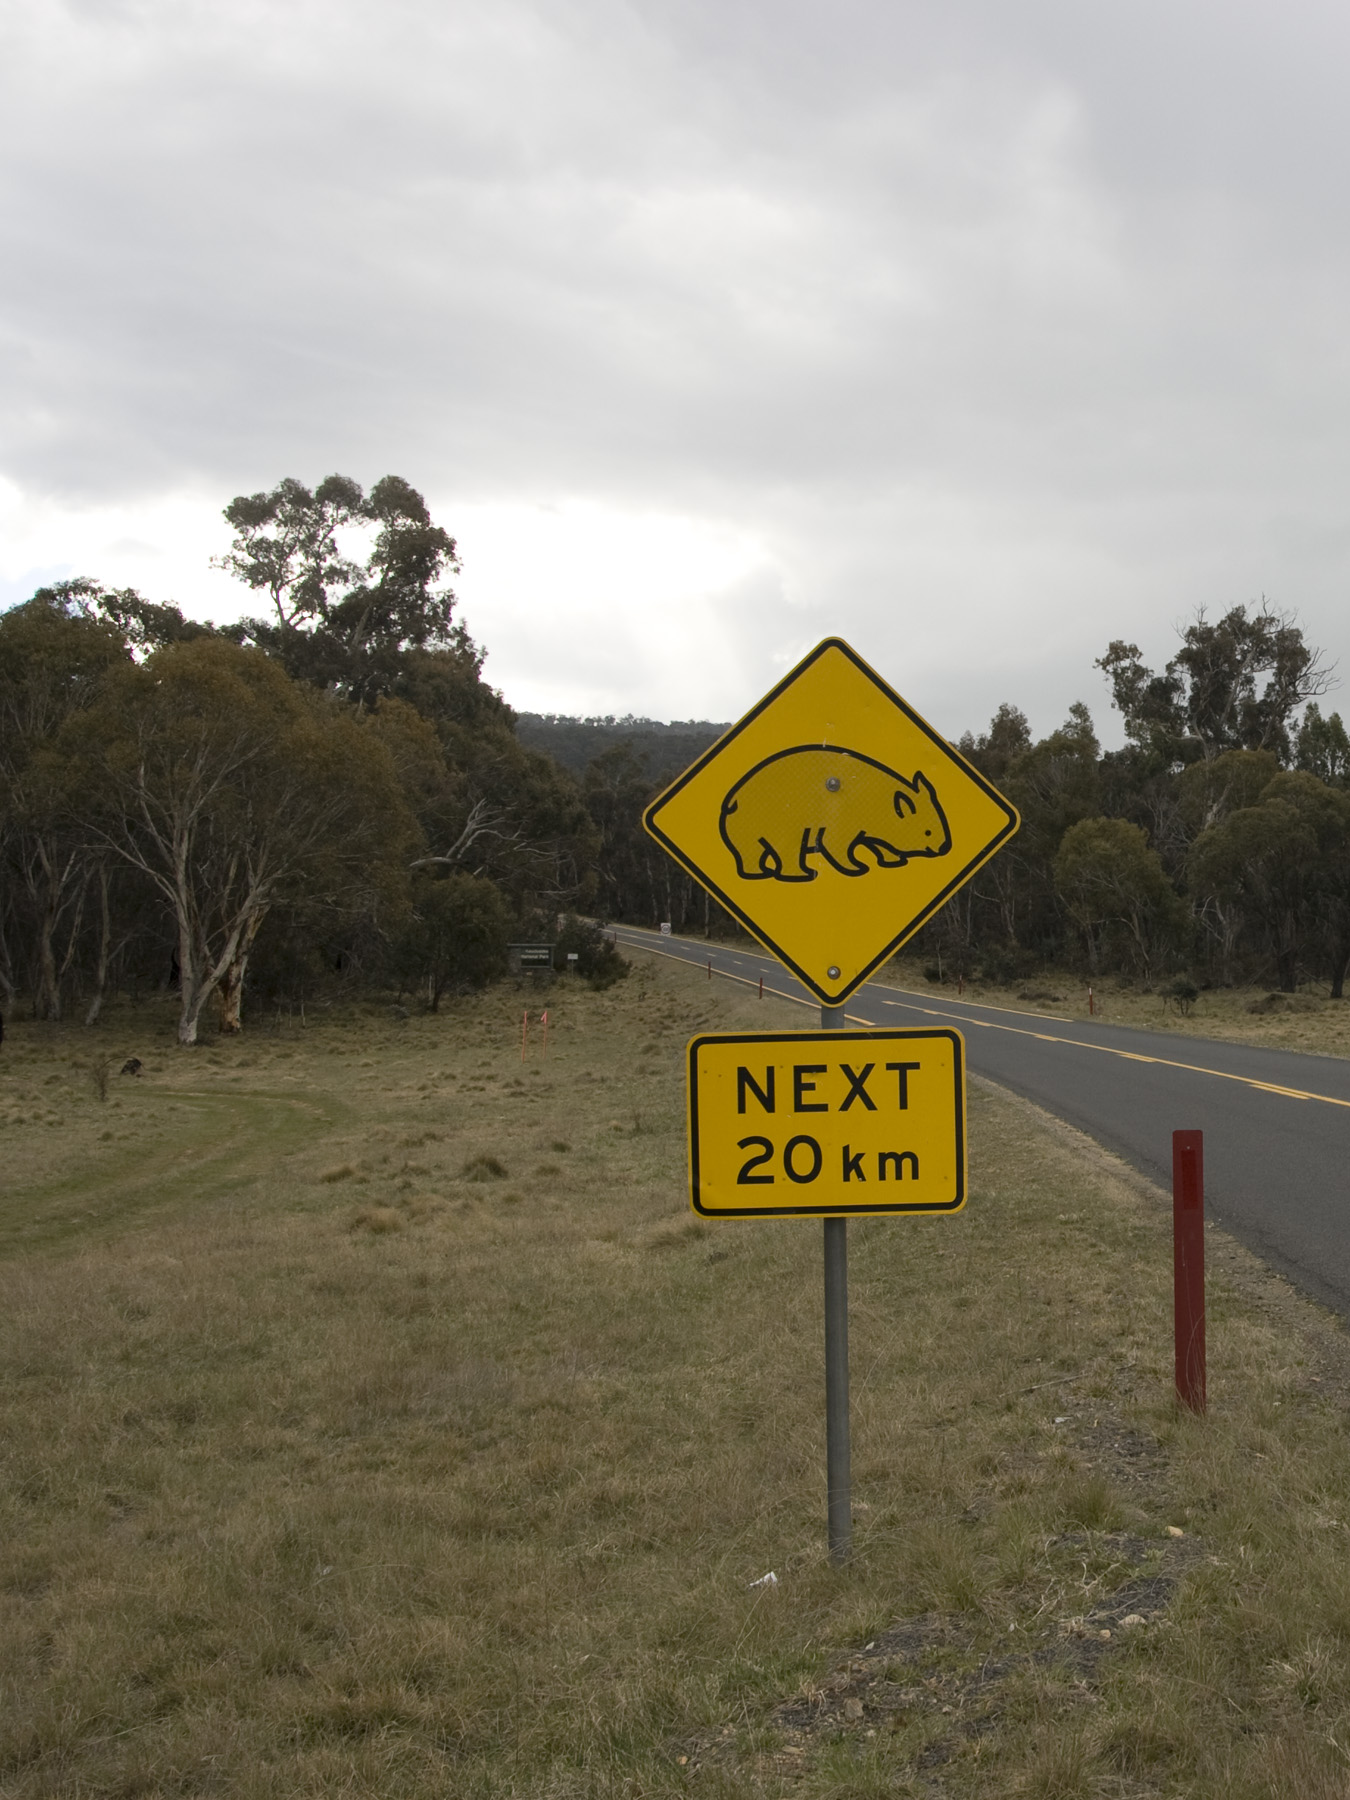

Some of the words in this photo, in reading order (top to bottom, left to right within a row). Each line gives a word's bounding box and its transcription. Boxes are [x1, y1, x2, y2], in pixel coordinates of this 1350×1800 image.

[737, 1062, 921, 1115] NEXT
[736, 1135, 823, 1185] 20
[842, 1144, 920, 1183] km
